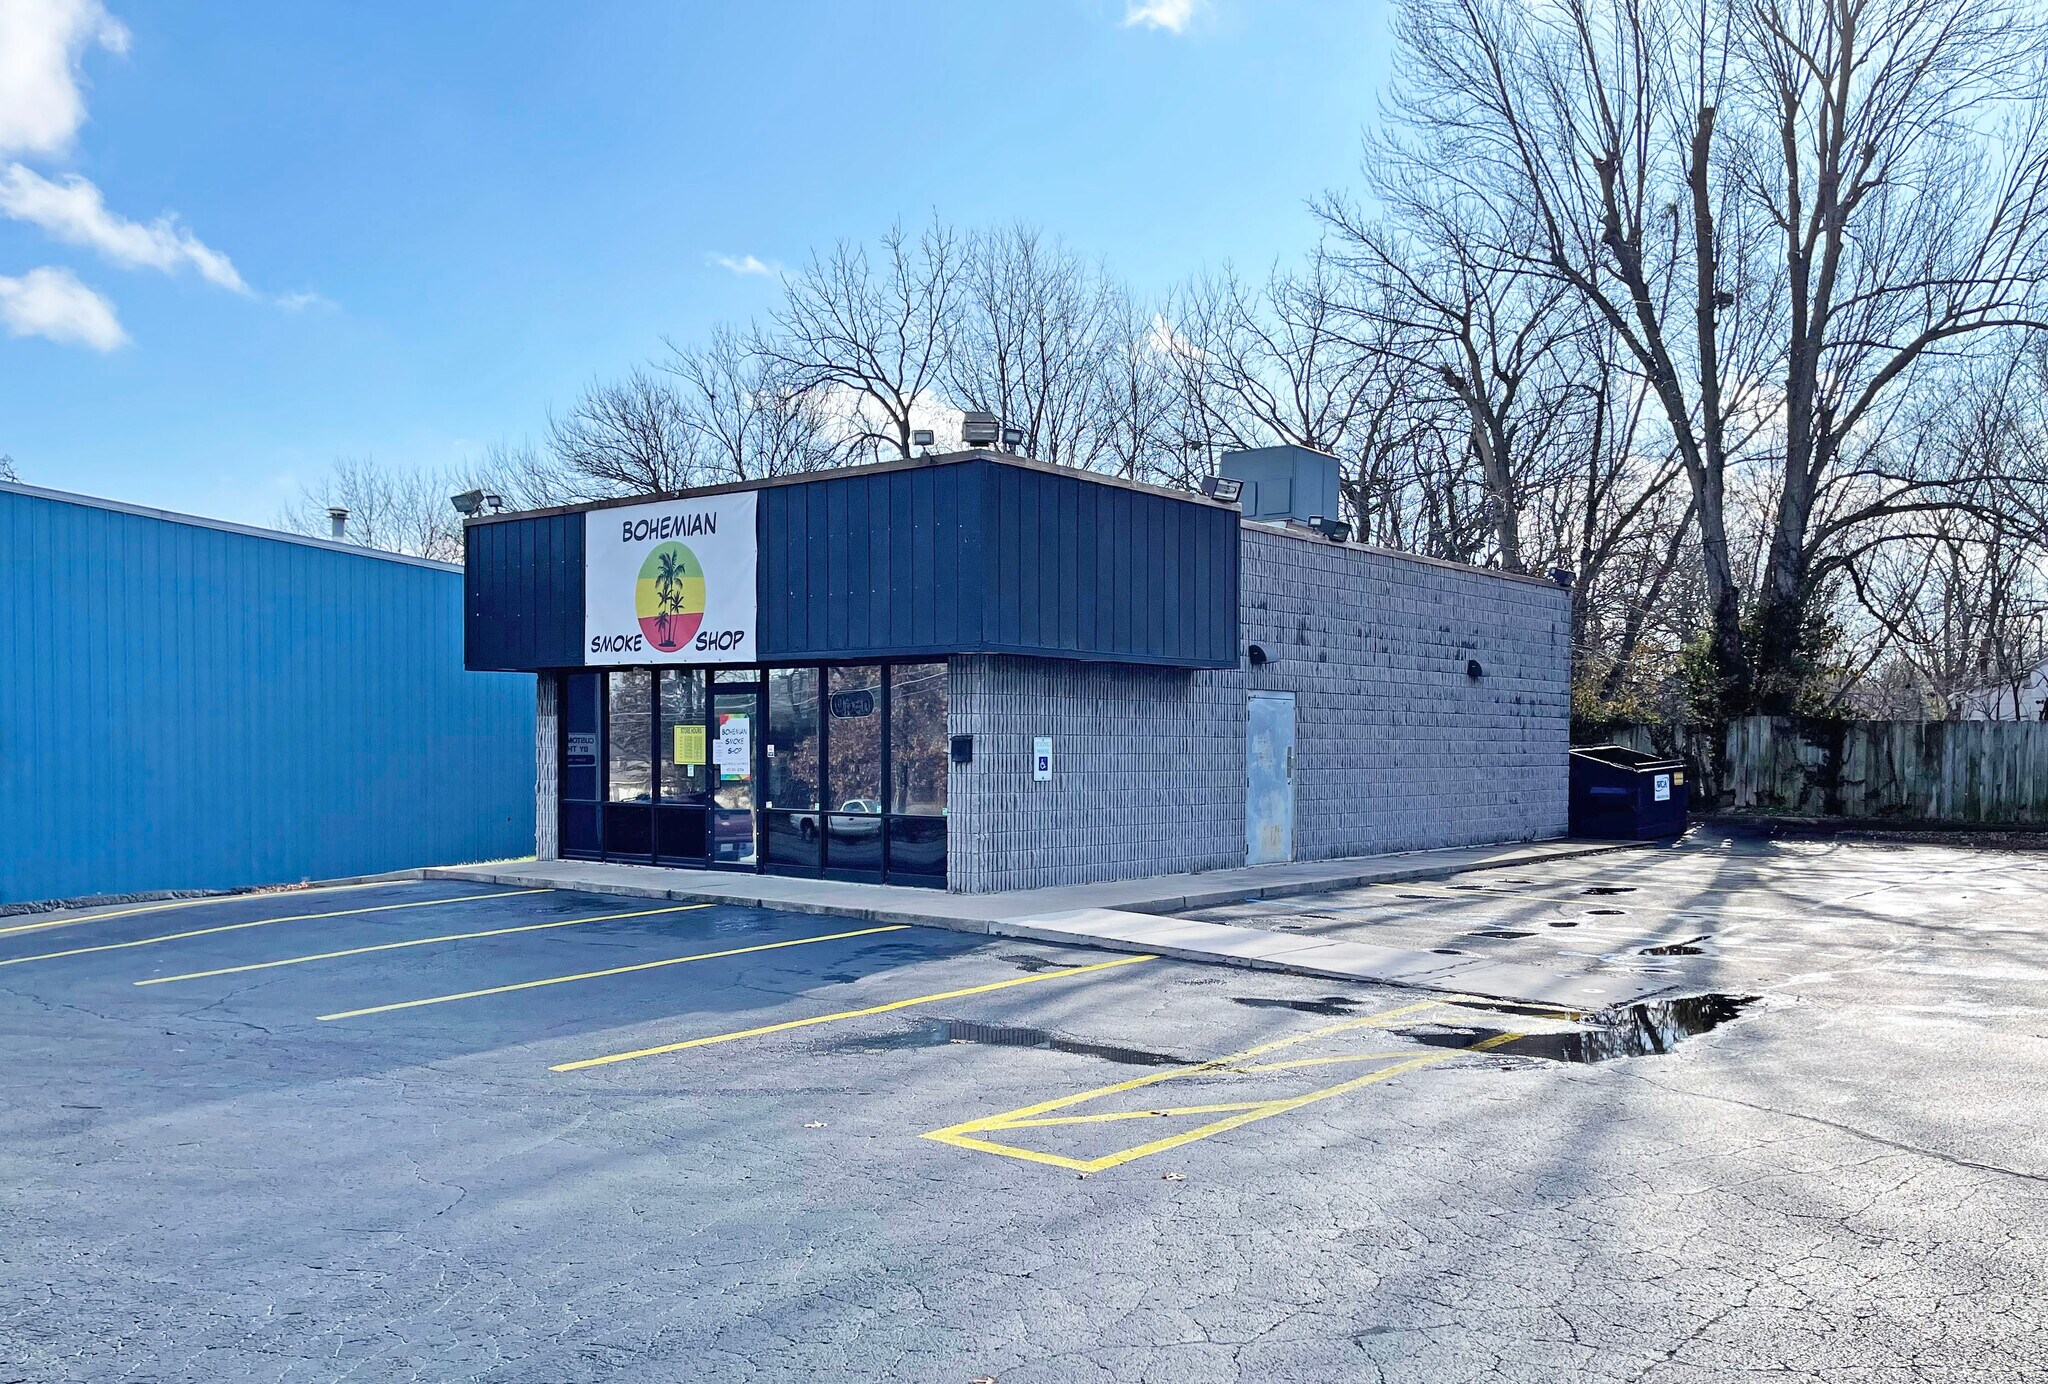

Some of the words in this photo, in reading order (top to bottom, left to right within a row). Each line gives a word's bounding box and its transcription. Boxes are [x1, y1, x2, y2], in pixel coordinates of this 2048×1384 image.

[622, 512, 717, 542] BOHEMIAN
[590, 634, 642, 653] SMOKE
[695, 630, 745, 651] SHOP
